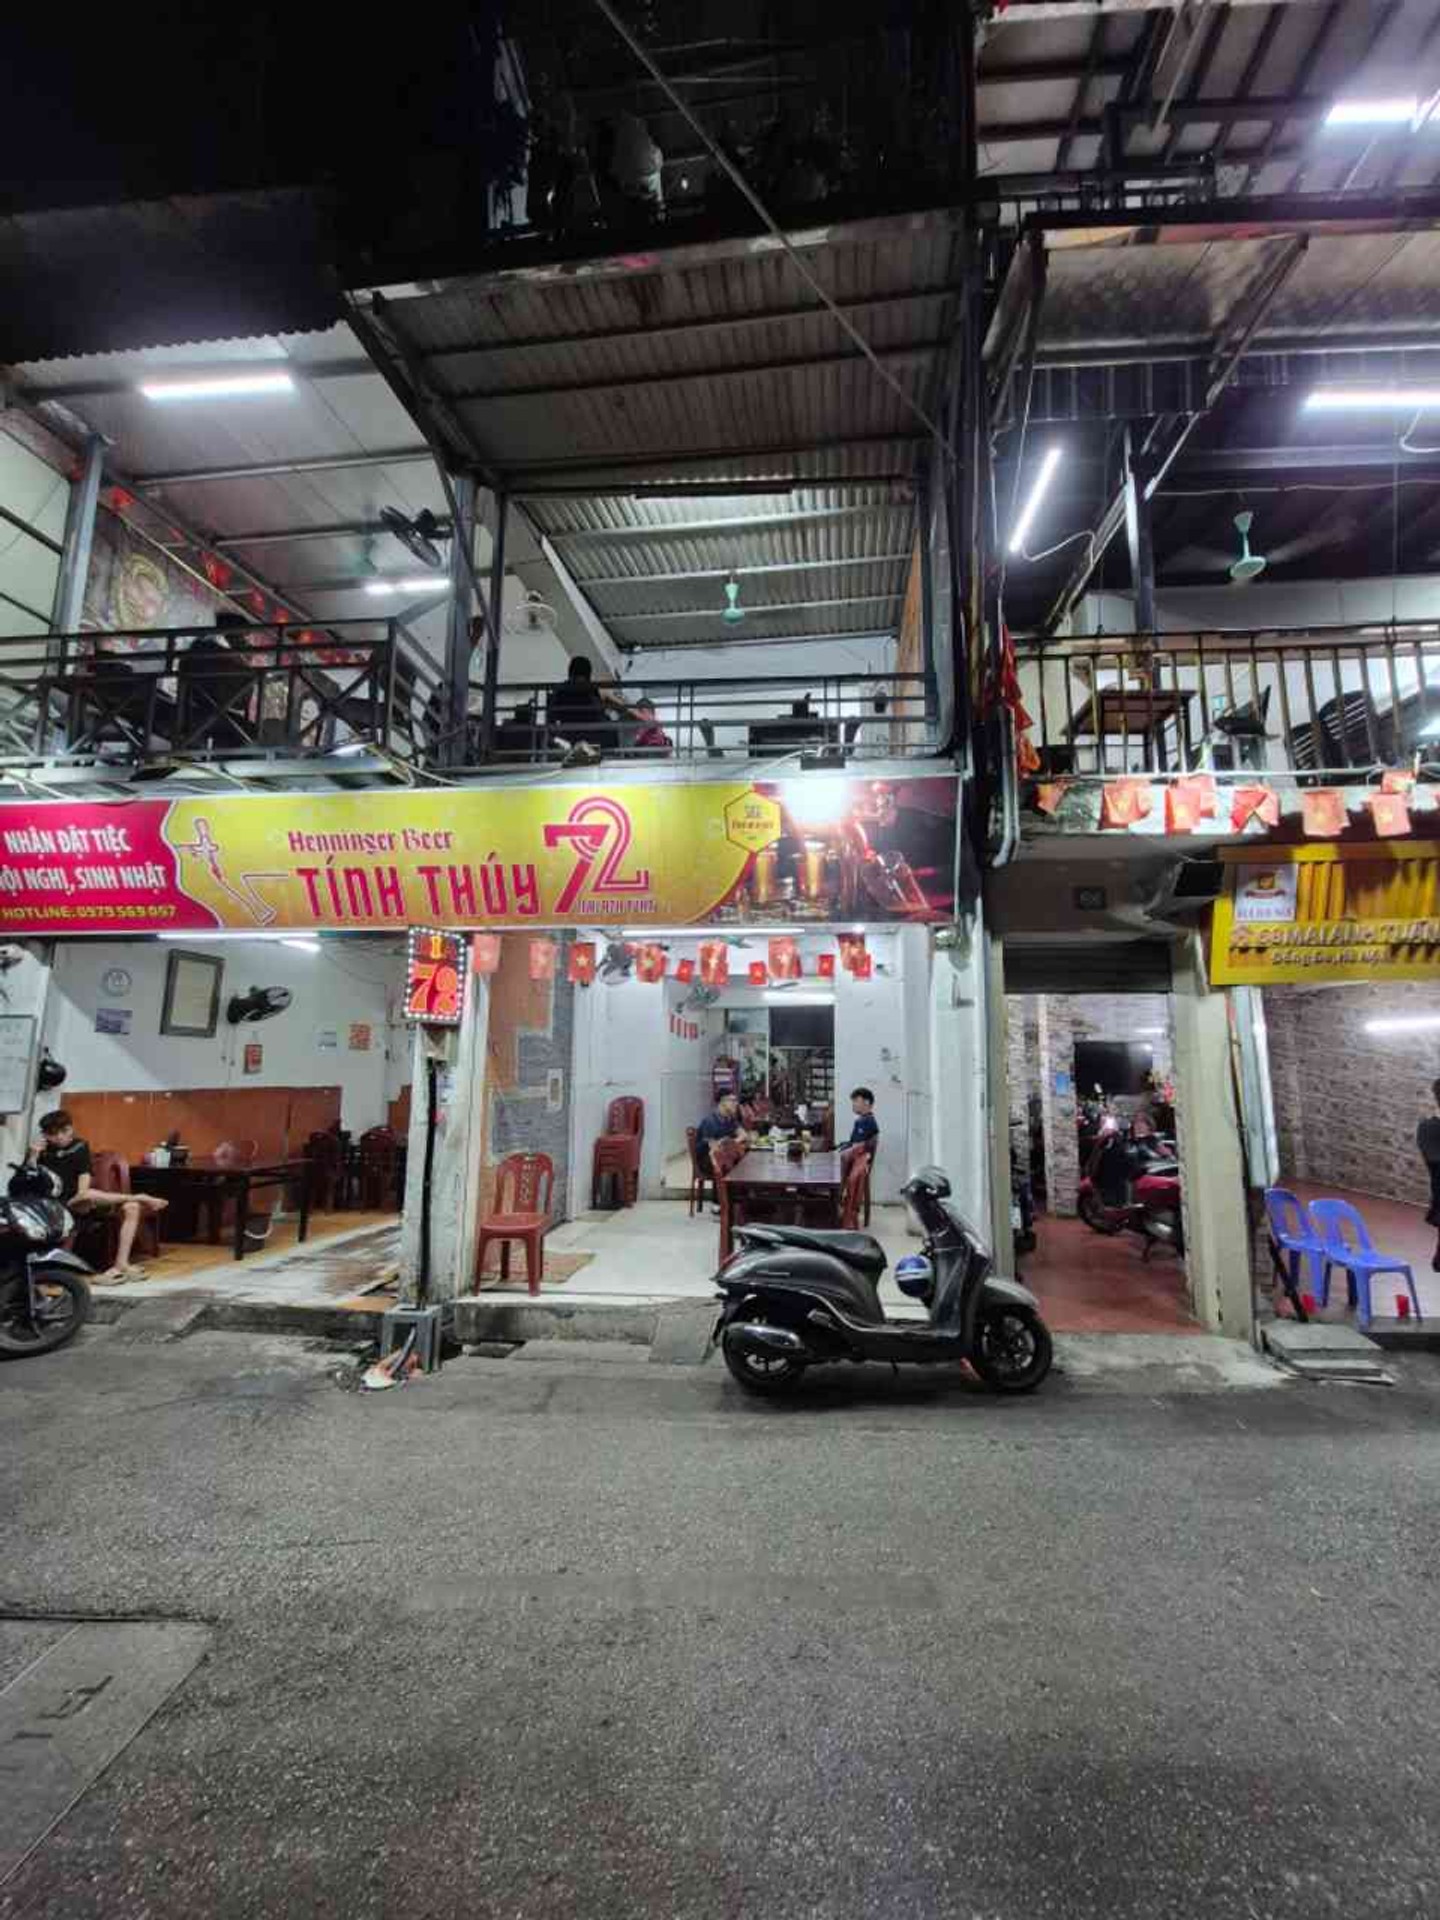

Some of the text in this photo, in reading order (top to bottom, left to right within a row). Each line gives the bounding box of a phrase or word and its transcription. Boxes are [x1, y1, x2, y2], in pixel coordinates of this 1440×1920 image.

[4, 824, 132, 860] NHẬN ĐẶT TIỆC
[288, 829, 453, 855] Henninger Beer
[544, 797, 648, 913] 72
[0, 861, 167, 897] ỘI NGHỊ, SINH NHẬT
[297, 851, 539, 917] TÍNH THÚY
